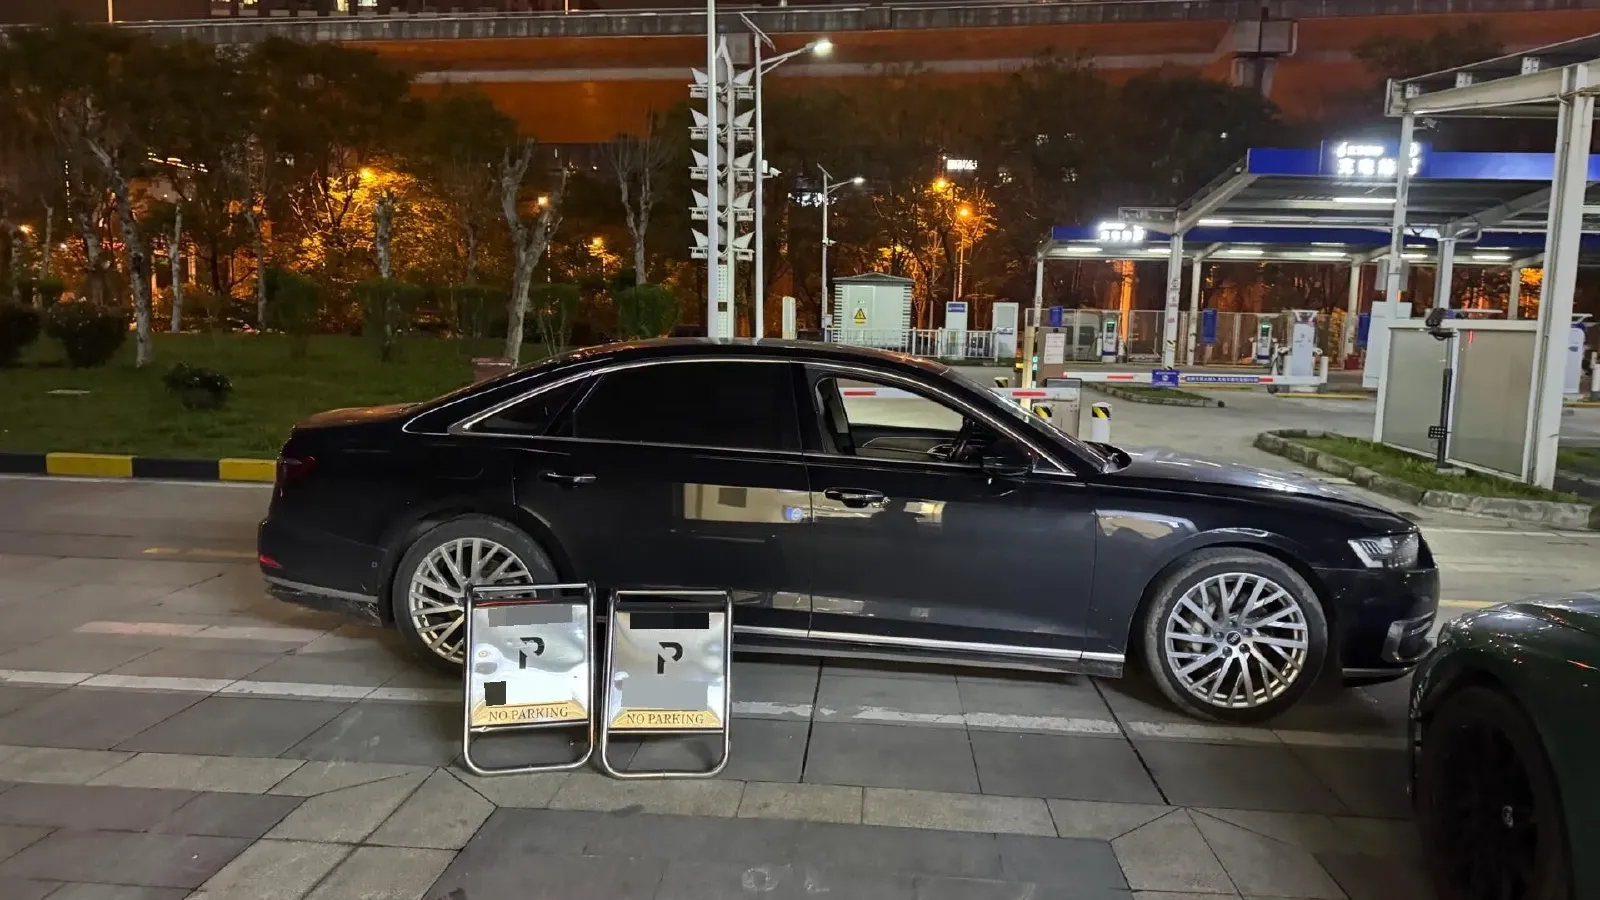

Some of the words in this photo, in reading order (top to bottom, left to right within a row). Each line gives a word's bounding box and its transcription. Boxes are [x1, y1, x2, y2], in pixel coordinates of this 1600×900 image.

[488, 710, 508, 721] NO
[511, 707, 568, 720] PARKING
[627, 713, 645, 724] NO
[648, 713, 704, 724] PARKING
